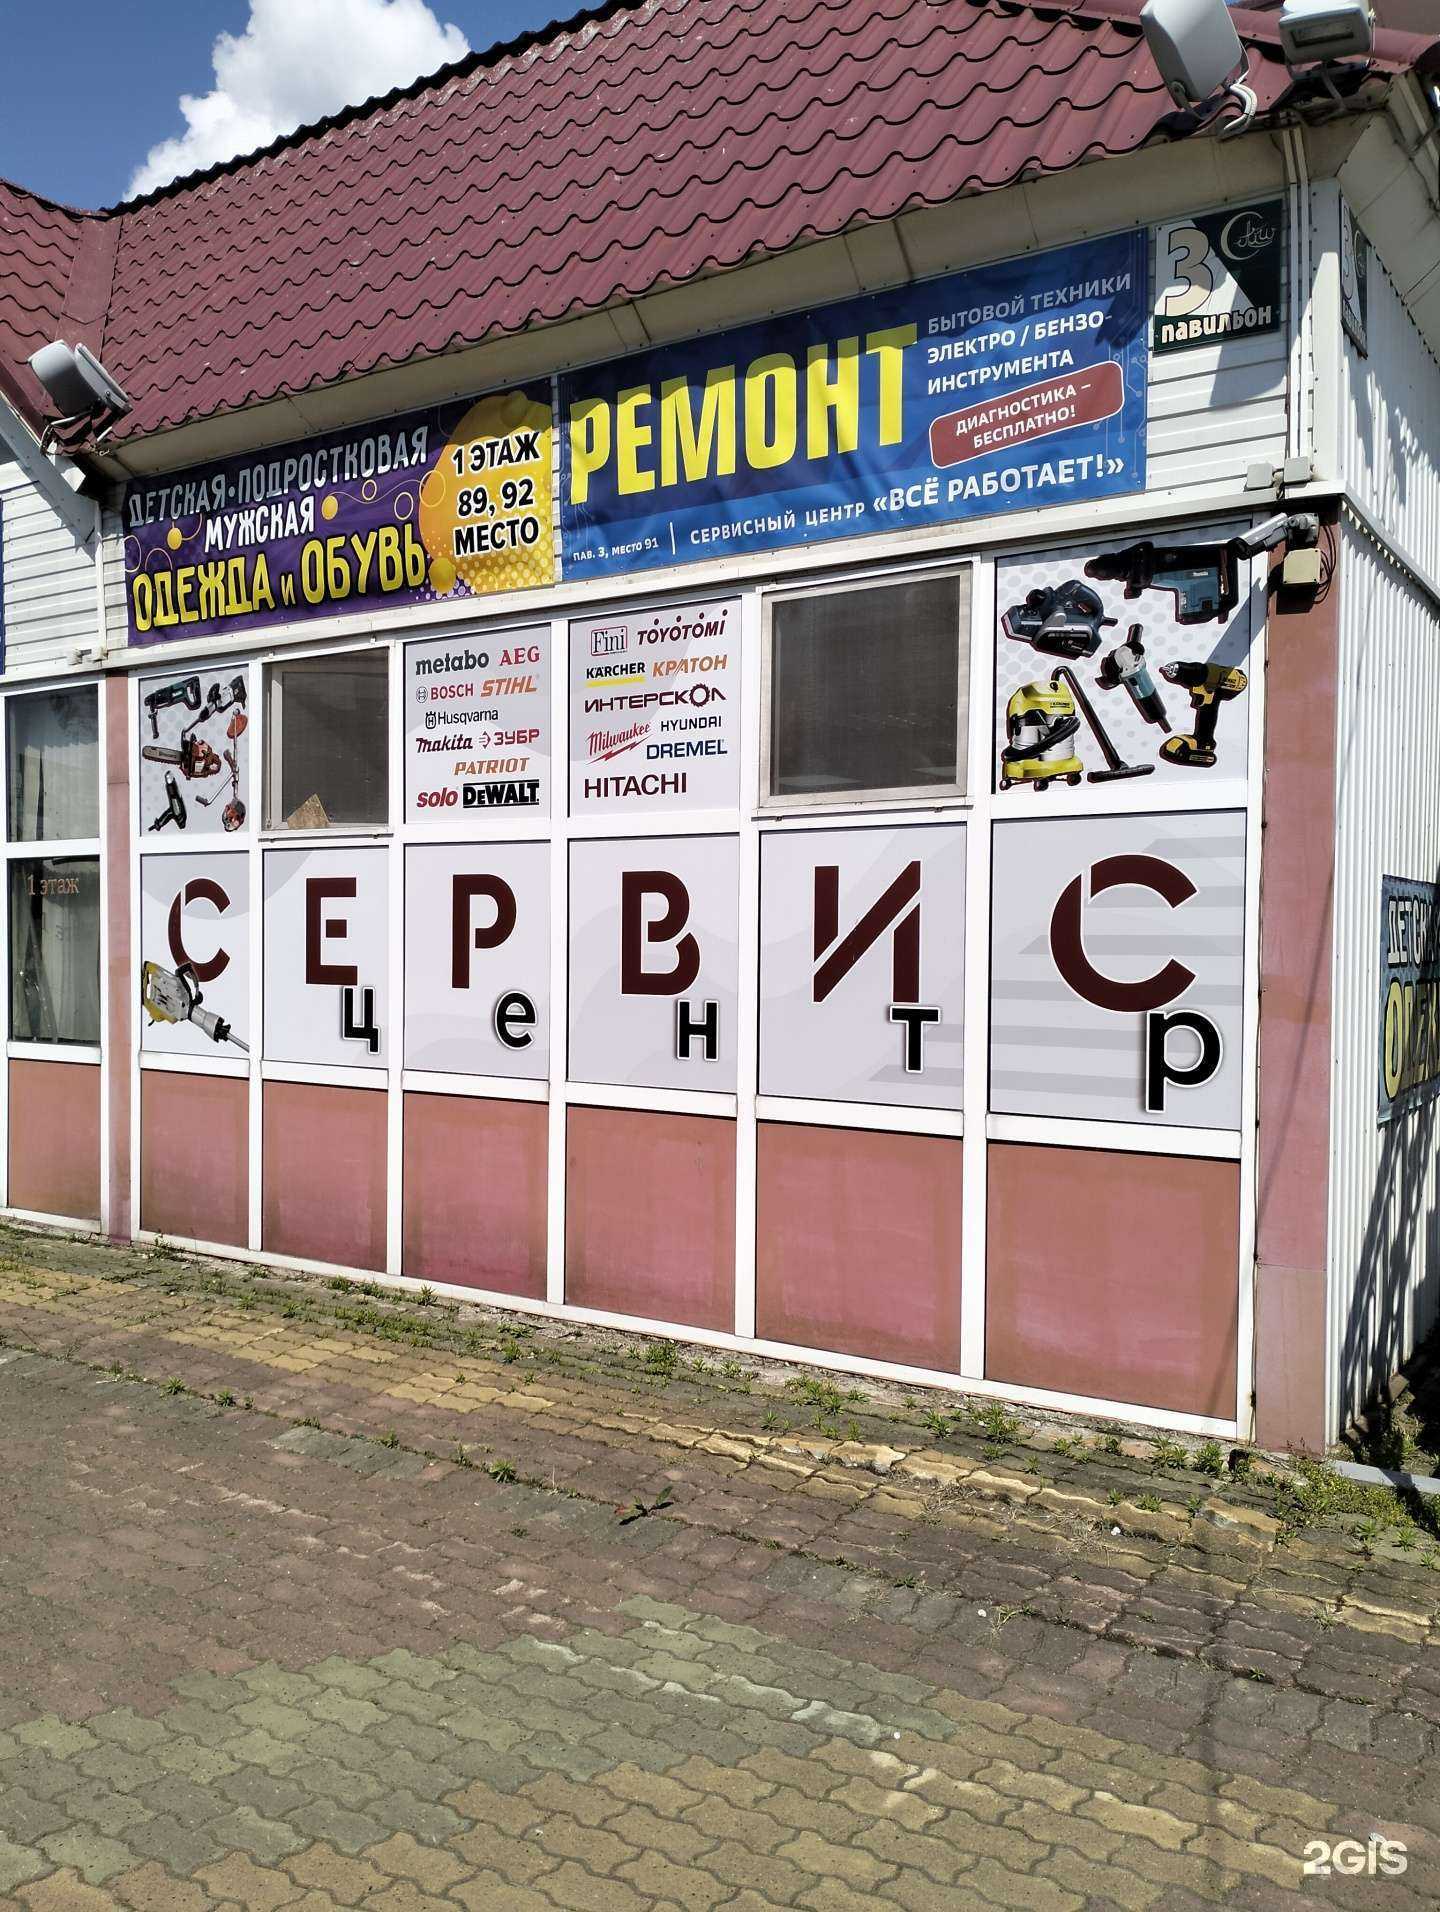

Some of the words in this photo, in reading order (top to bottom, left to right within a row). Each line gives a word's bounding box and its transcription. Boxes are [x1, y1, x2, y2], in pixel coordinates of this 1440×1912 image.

[1163, 226, 1214, 317] 3
[928, 295, 1025, 334] БЫТОВОЙ
[1030, 272, 1131, 311] ТЕХНИКИ
[1160, 304, 1272, 344] павильон
[927, 330, 1016, 364] ЭЛЕКТРО
[927, 348, 1074, 395] ИНСТРУМЕНТА
[569, 321, 918, 506] РЕМОНТ
[955, 384, 1077, 437] ДИАГНОСТИКА
[973, 404, 1076, 450] БЕСПЛАТНО!
[452, 449, 466, 476] 1
[470, 431, 541, 470] ЭТАЖ
[457, 488, 496, 520] 89,
[502, 478, 535, 507] 92
[690, 509, 797, 545] СЕРВИСНЫЙ
[805, 501, 866, 527] ЦЕНТР
[873, 476, 939, 511] «ВСЁ
[947, 453, 1125, 502] РАБОТАЕТ!»
[204, 495, 315, 552] МУЖСКАЯ
[453, 516, 540, 557] МЕСТО
[644, 537, 659, 550] 91
[131, 552, 276, 632] ОДЕЖДА
[300, 523, 427, 604] ОБУВЬ
[592, 628, 627, 654] Fini
[636, 609, 728, 646] TOYOTOMI
[415, 649, 490, 676] metabo
[499, 645, 540, 667] AEG
[652, 654, 728, 678] КРАТОН
[430, 683, 474, 701] BOSCH
[480, 675, 538, 698] STIHL
[584, 683, 727, 714] ИНТЕРСКОЛ
[437, 708, 499, 727] Husqvarna
[660, 715, 722, 732] HYUNDAI
[493, 728, 541, 746] ЗУБР
[587, 723, 652, 757] Milwaukee
[646, 739, 728, 760] DREMEL
[453, 756, 530, 776] PATRIOT
[416, 786, 459, 808] solo
[584, 772, 687, 799] HITACHI
